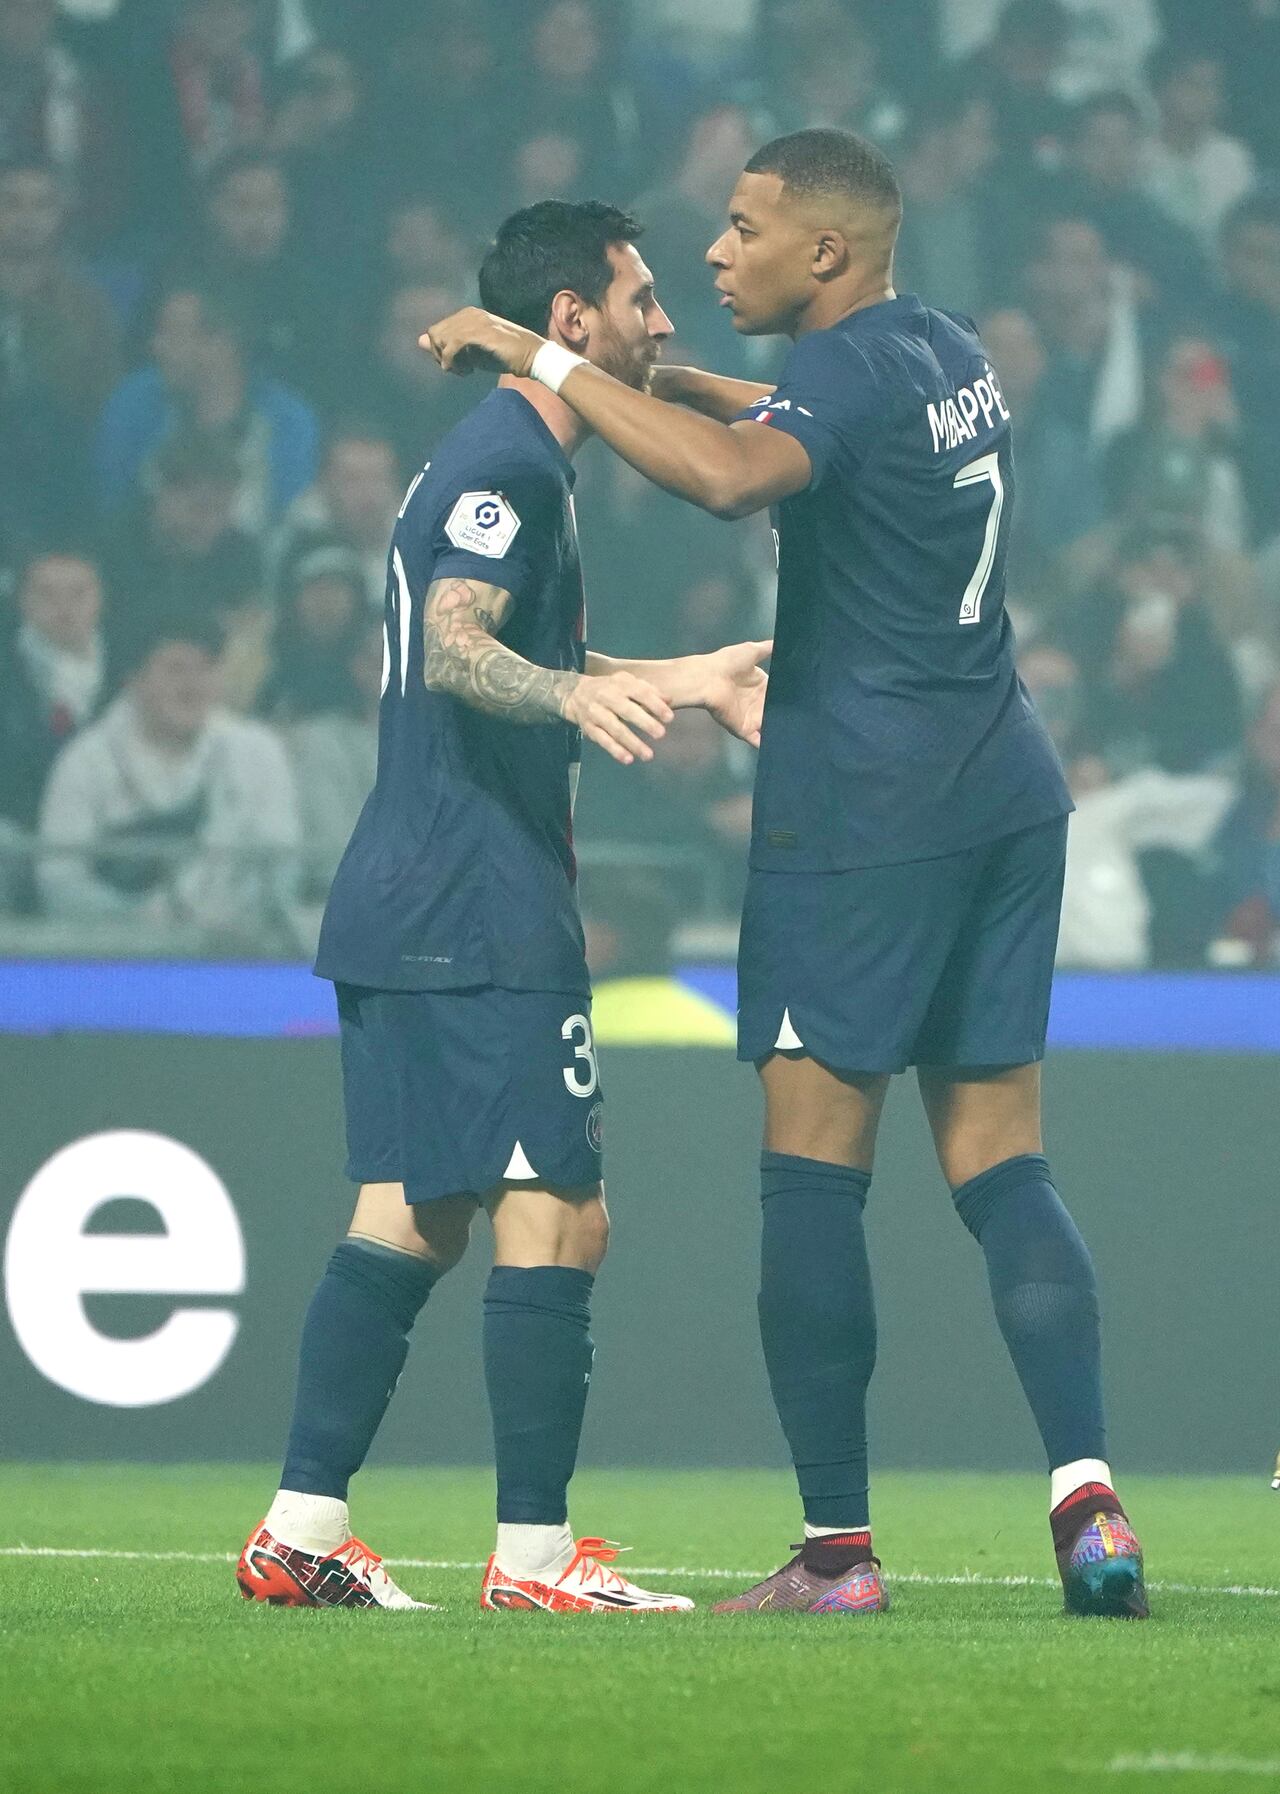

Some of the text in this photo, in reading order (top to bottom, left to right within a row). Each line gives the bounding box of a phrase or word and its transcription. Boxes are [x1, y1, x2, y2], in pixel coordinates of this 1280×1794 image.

[927, 362, 1010, 453] MBAPPÉ
[953, 451, 1003, 625] 7
[561, 1013, 599, 1098] 3
[3, 1128, 247, 1408] e
